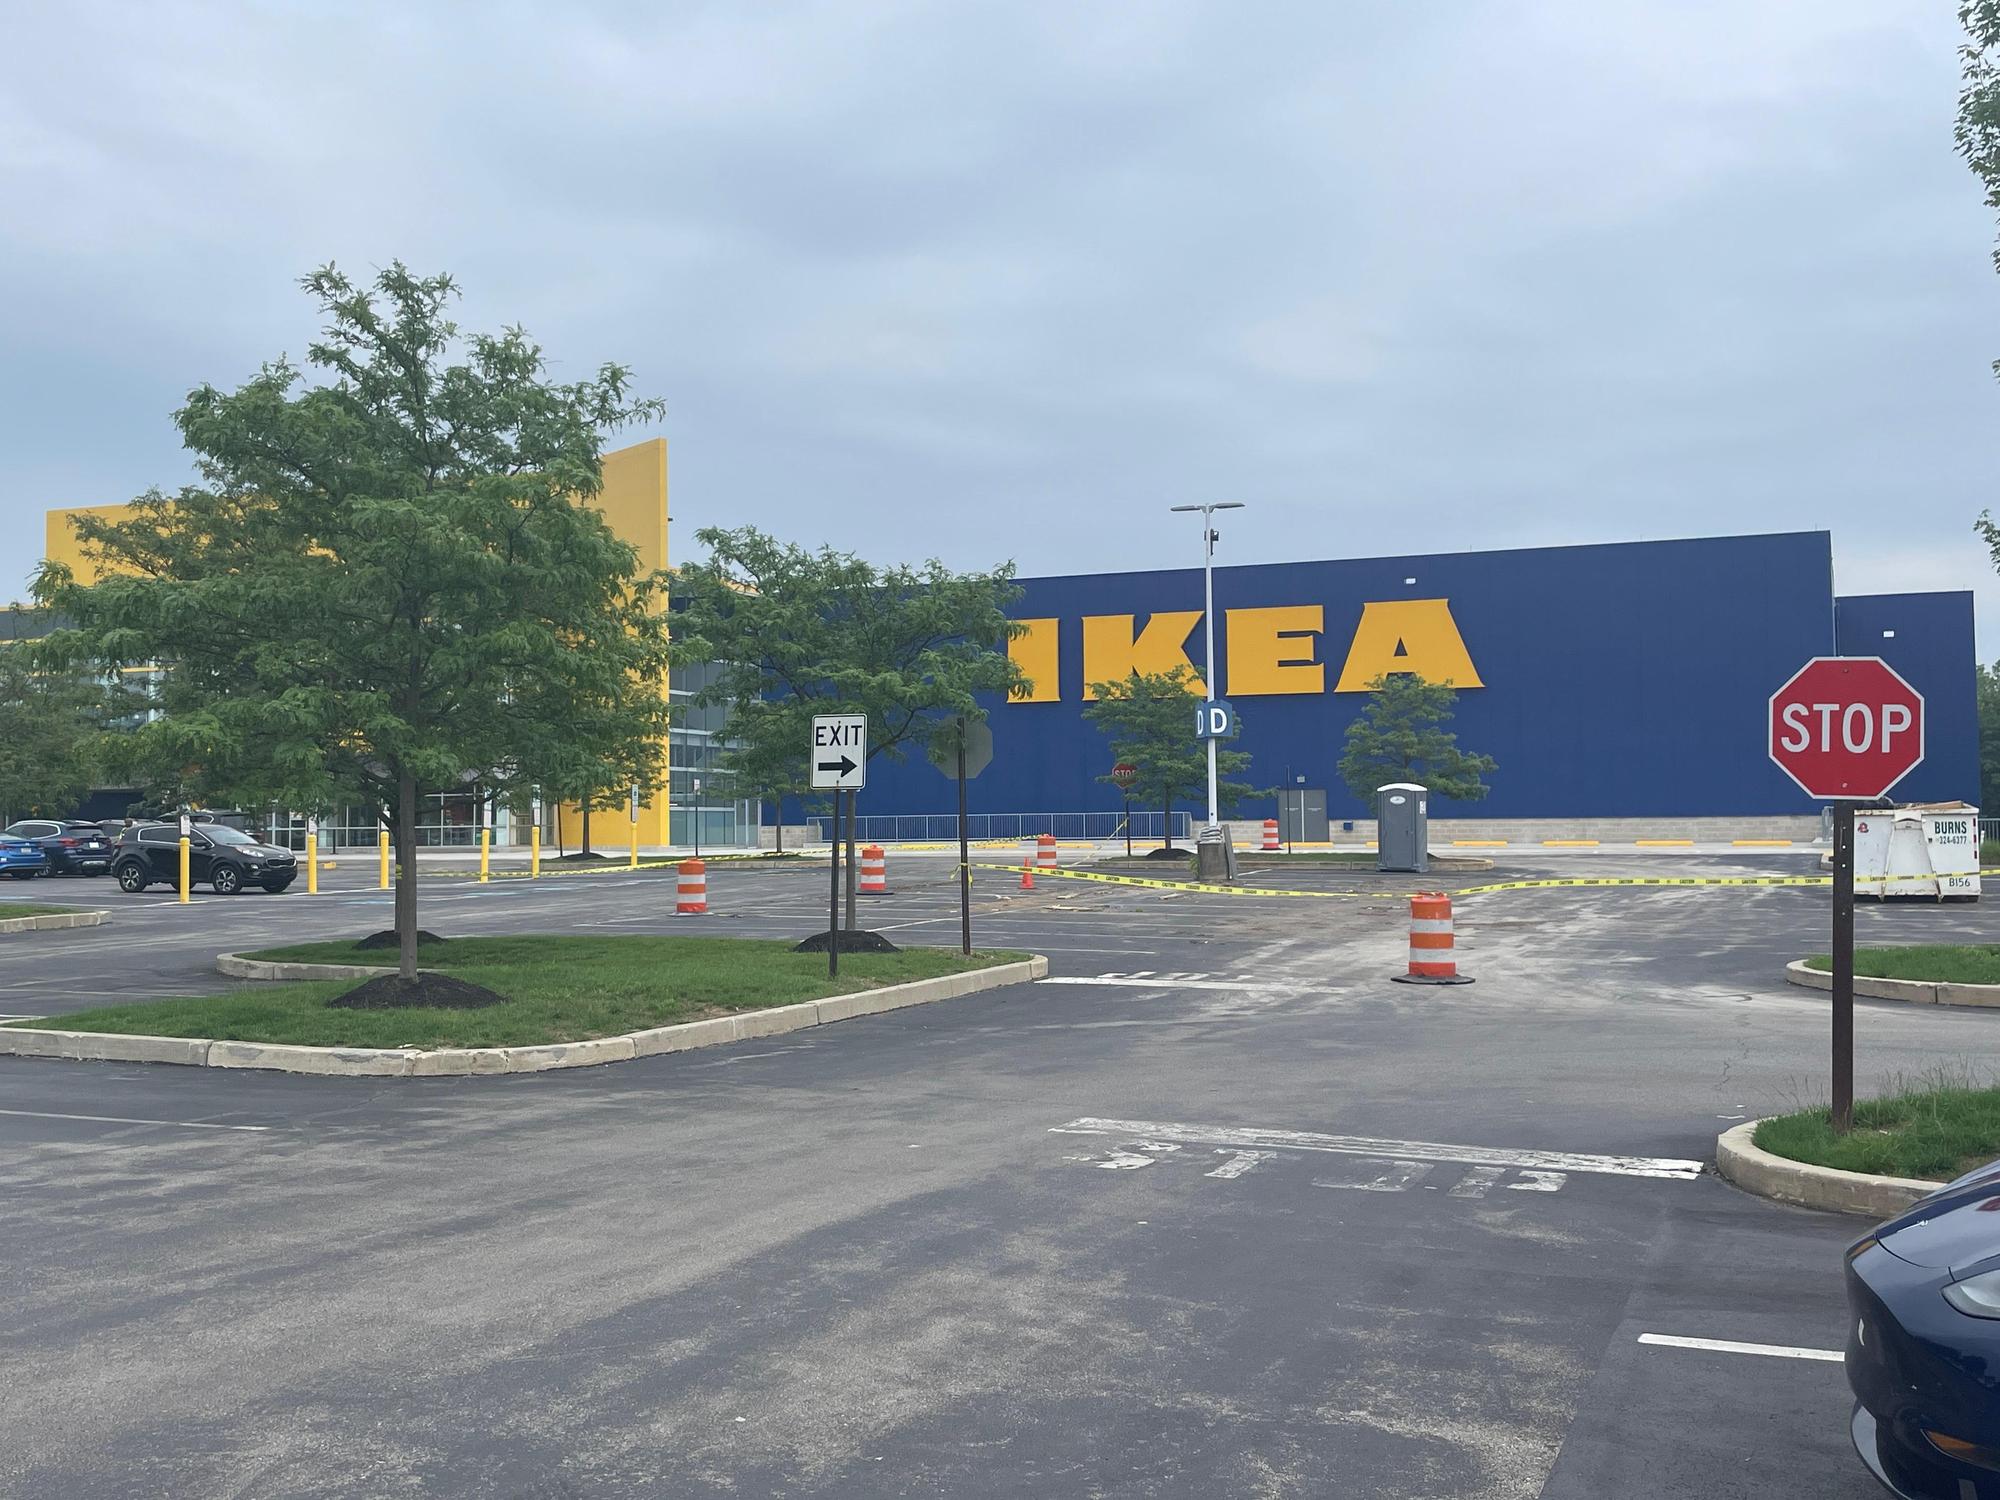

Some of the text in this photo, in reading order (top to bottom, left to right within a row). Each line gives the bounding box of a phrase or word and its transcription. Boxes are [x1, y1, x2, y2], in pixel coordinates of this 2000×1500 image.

[1007, 599, 1485, 703] IKEA
[1210, 708, 1227, 734] D
[1781, 703, 1912, 753] STOP
[815, 725, 863, 747] EXIT
[1934, 821, 1967, 834] BURNS
[1949, 877, 1971, 888] B156
